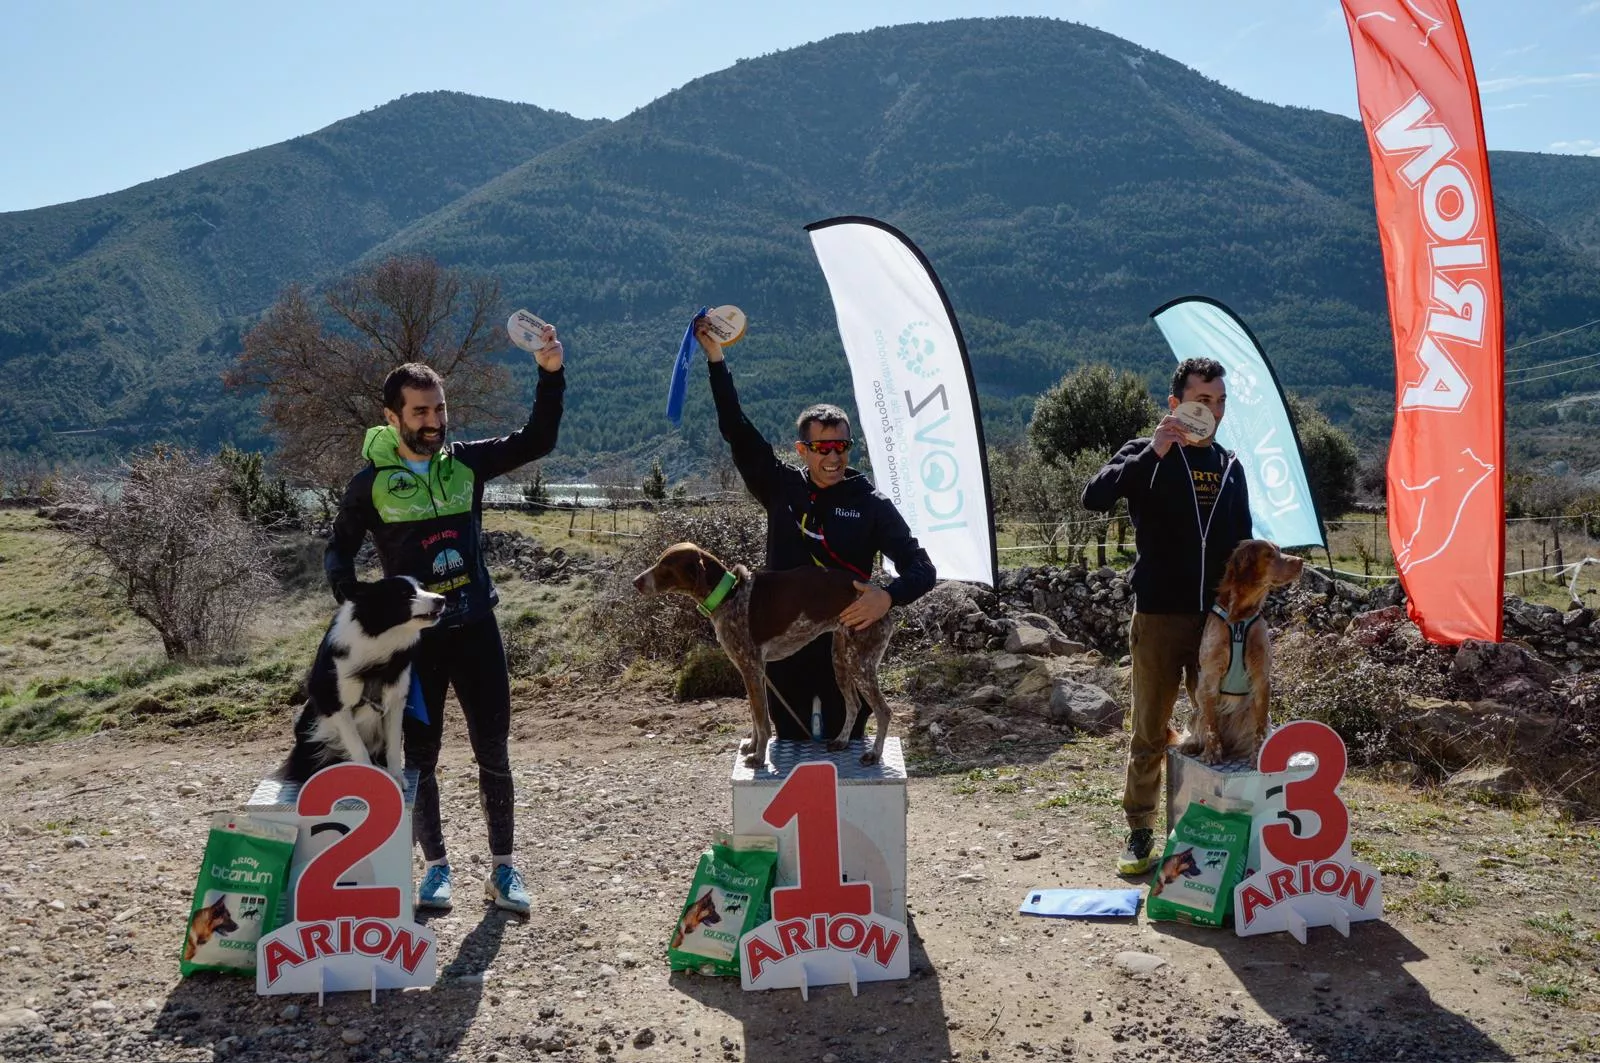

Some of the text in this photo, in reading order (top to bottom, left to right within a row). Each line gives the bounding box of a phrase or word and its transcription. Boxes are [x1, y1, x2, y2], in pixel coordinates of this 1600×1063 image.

[1258, 721, 1349, 866] 3
[211, 863, 273, 885] titanium
[230, 856, 260, 869] ARION
[297, 763, 404, 921] 2
[763, 762, 873, 921] 1
[1238, 860, 1377, 930] ARION
[263, 917, 431, 988] ARION
[744, 913, 904, 984] ARION
